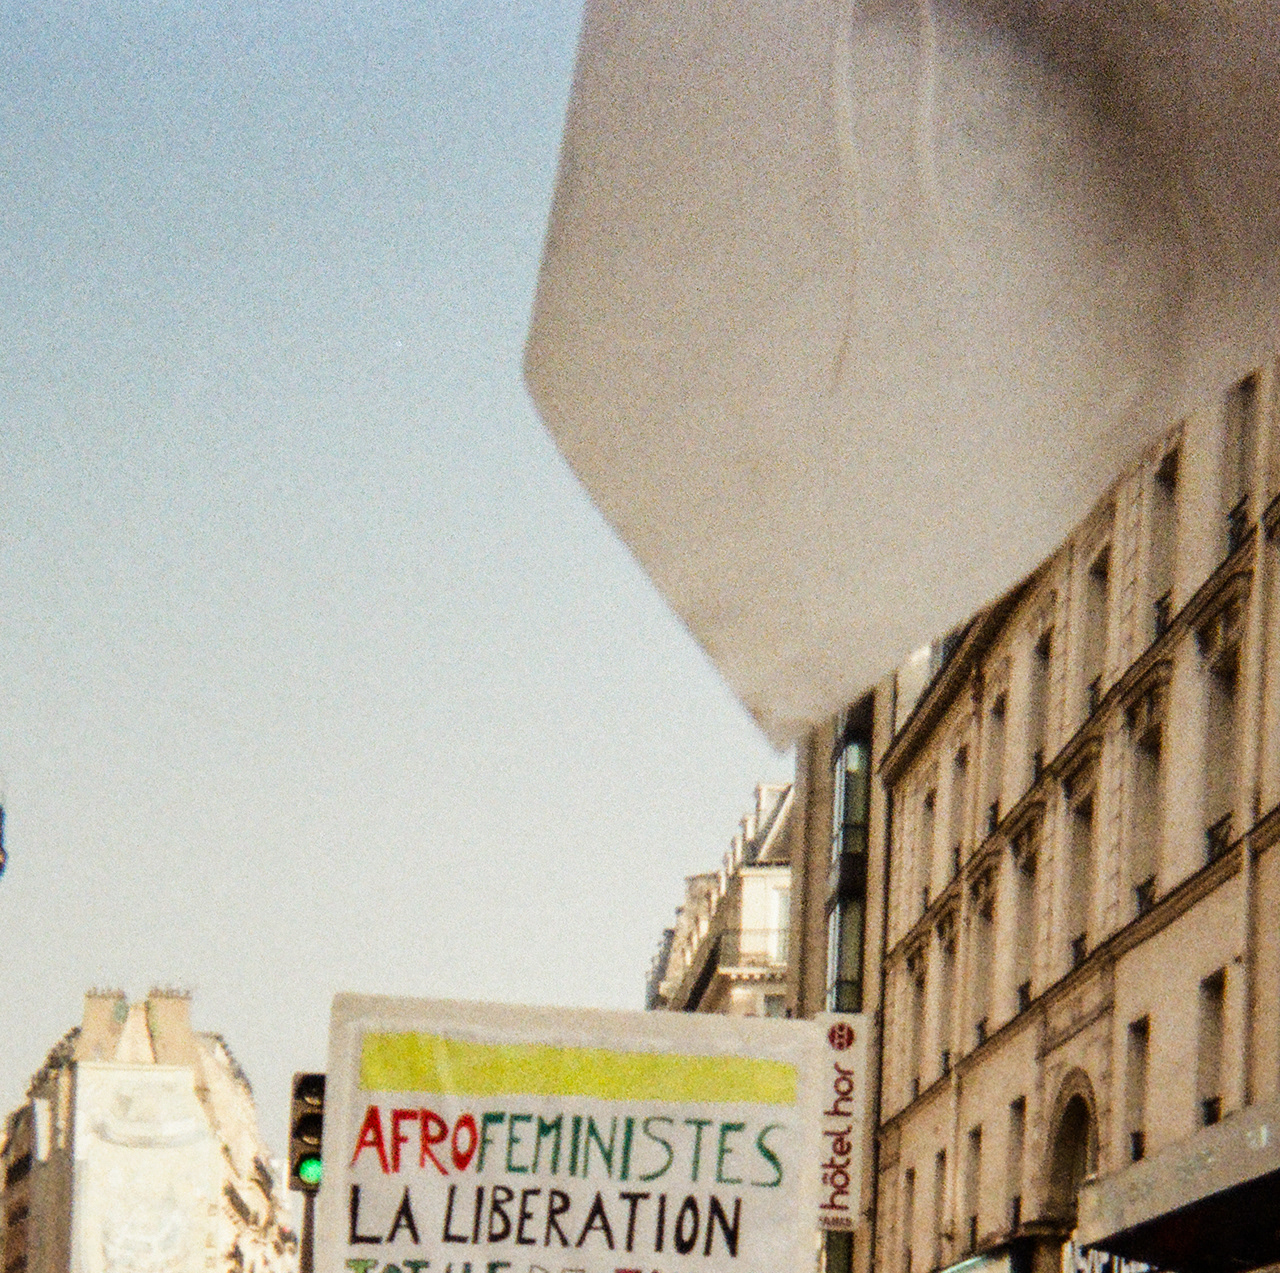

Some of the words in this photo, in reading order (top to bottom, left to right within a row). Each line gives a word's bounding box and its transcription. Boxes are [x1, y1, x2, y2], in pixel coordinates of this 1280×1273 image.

[824, 1061, 855, 1118] hor
[350, 1104, 787, 1188] AFROFEMINISTES
[819, 1125, 852, 1213] hôtel
[346, 1184, 420, 1245] LA
[442, 1185, 744, 1257] LIBERATION
